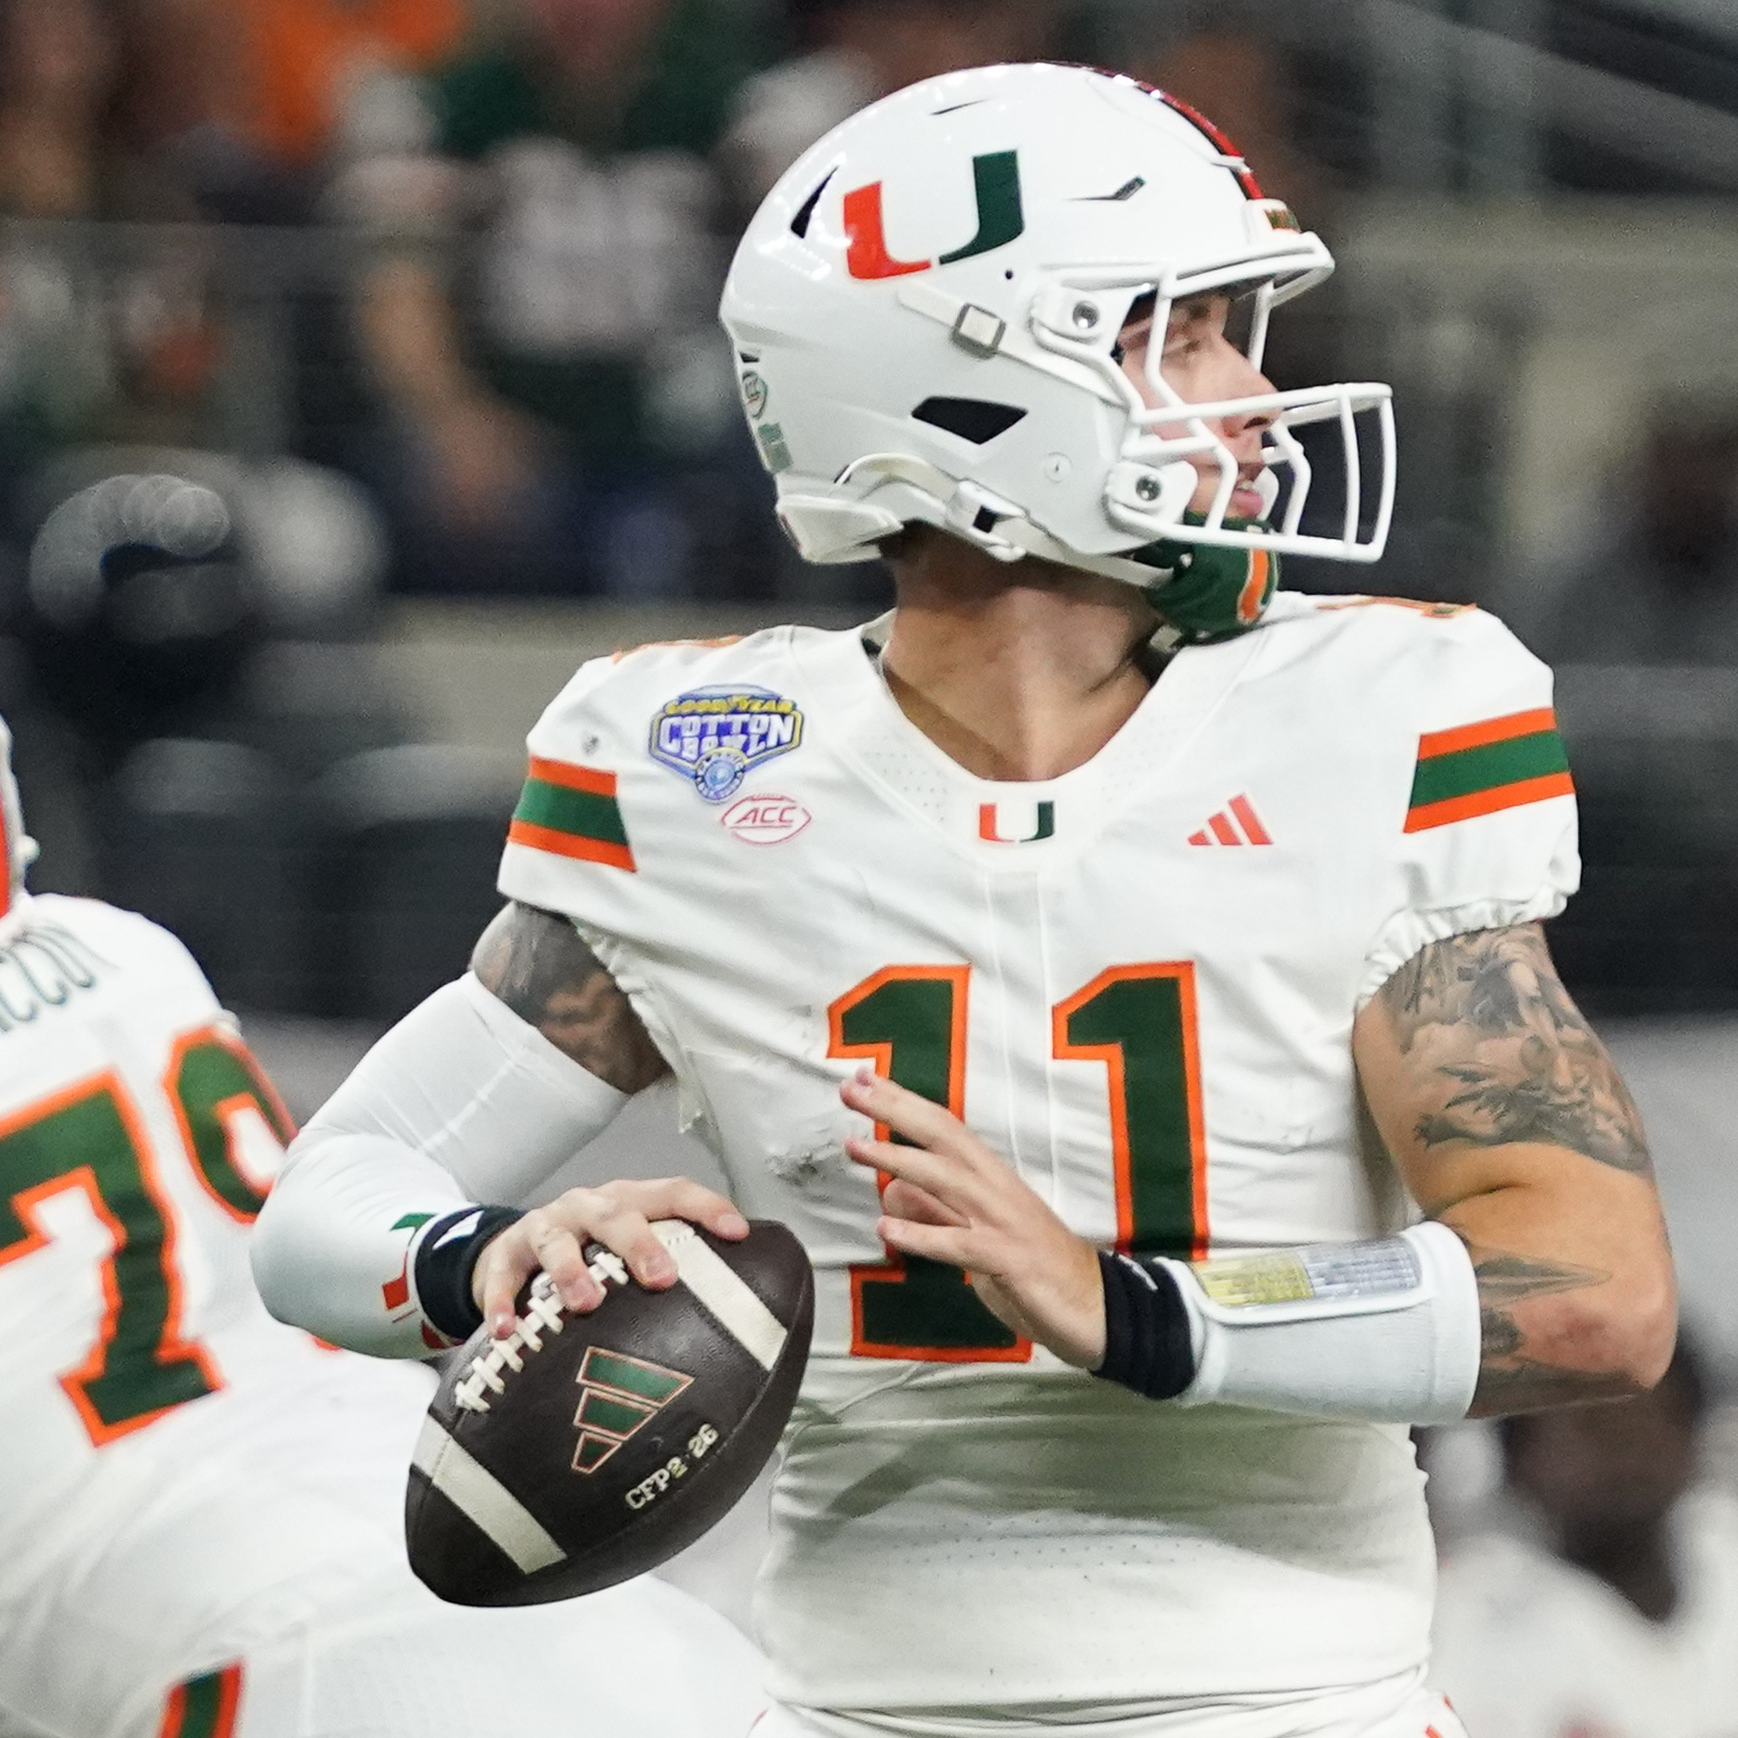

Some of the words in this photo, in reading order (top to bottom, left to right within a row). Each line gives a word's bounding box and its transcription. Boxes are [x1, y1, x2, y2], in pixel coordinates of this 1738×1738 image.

[843, 149, 1025, 280] U
[659, 713, 794, 755] COTTON
[736, 806, 797, 824] ACC
[979, 801, 1055, 843] U
[826, 960, 1209, 1363] 11
